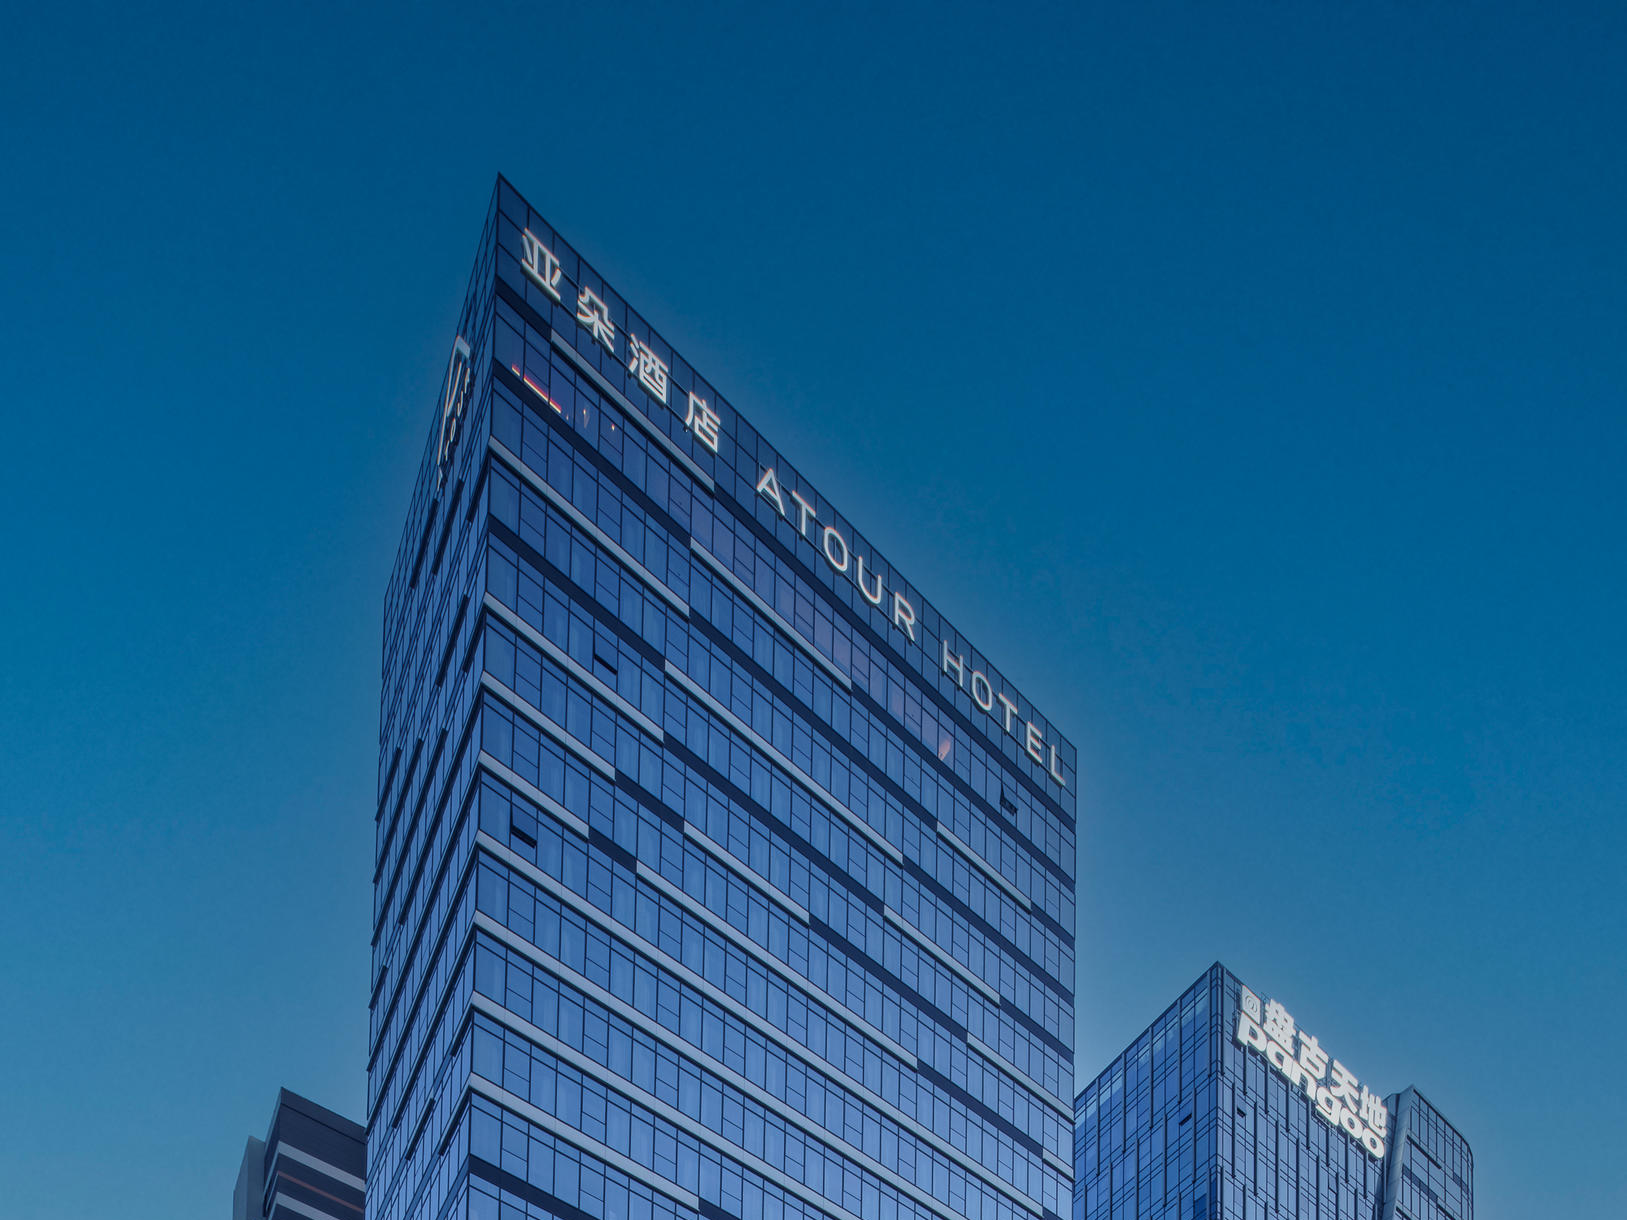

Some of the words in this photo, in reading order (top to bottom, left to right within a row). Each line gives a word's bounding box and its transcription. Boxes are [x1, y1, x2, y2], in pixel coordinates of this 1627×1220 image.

[521, 227, 721, 453] 亚朵酒店
[757, 468, 915, 642] ATOUR
[943, 640, 1066, 786] HOTEL
[1236, 1011, 1385, 1159] pangoo
